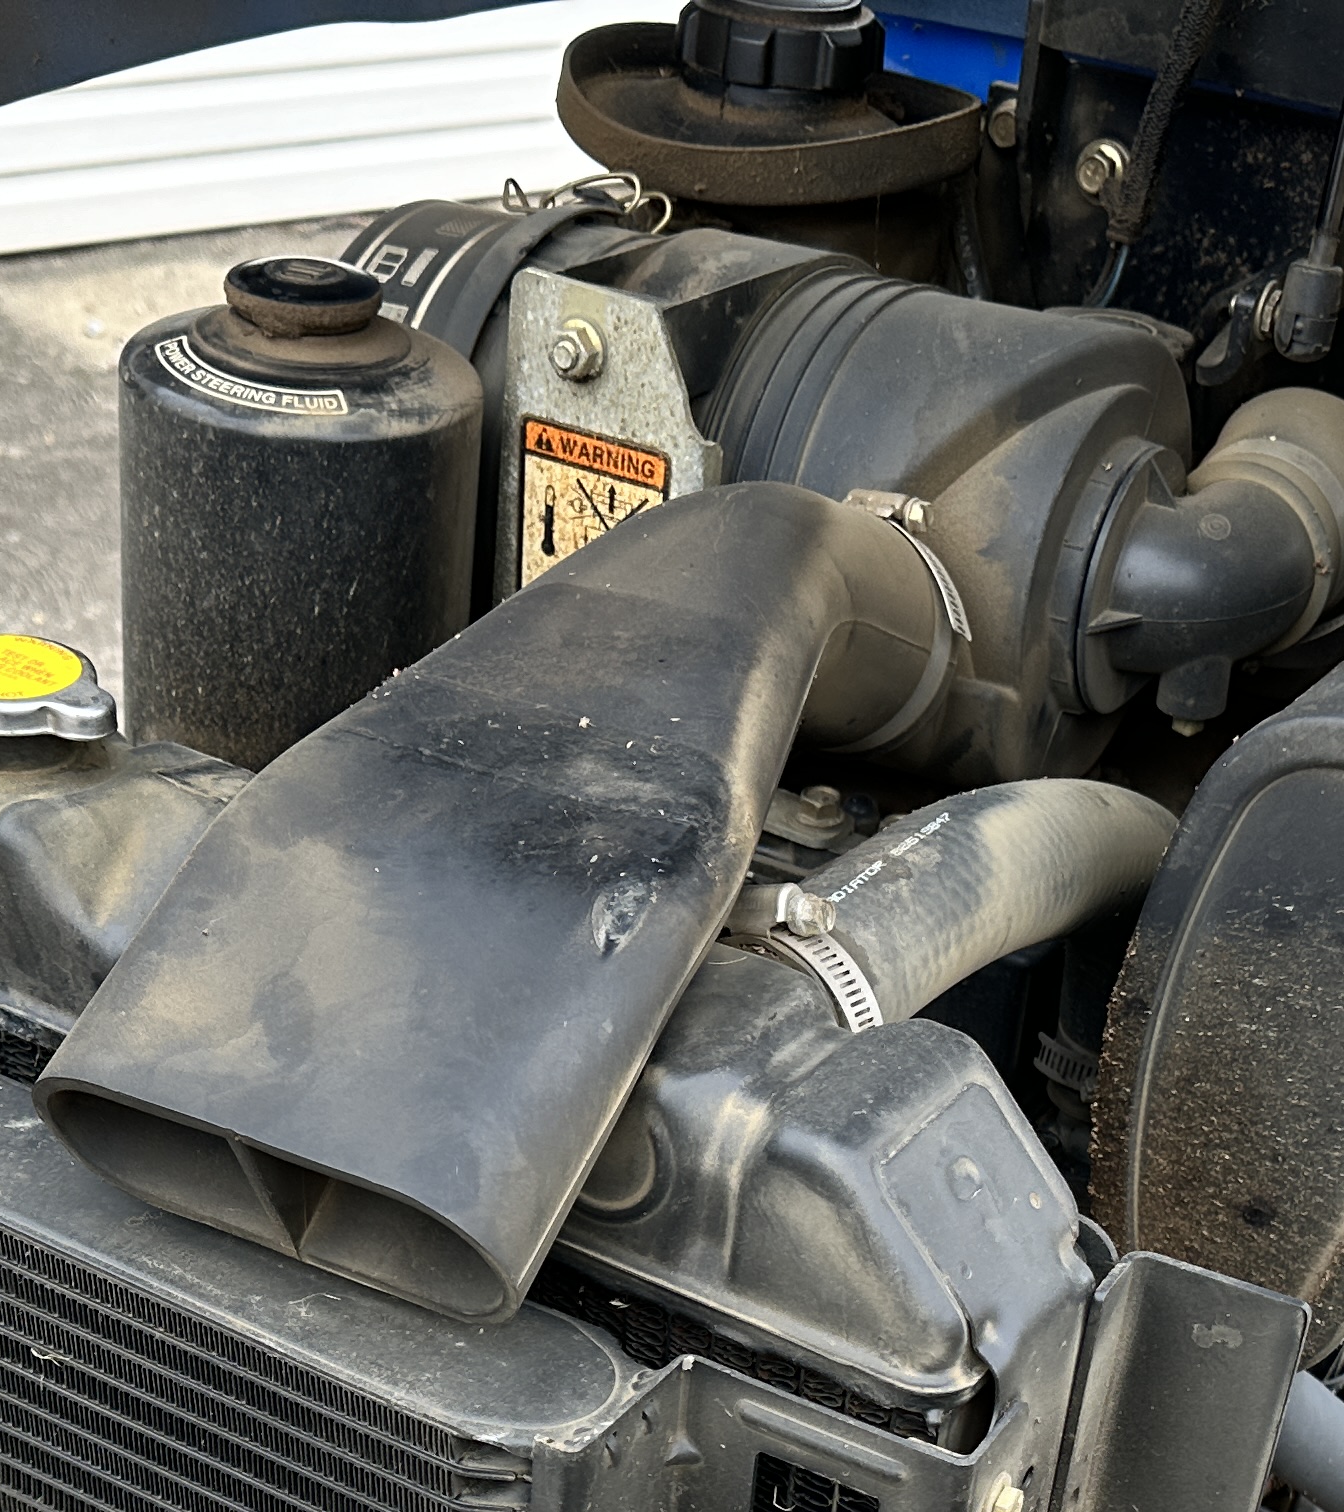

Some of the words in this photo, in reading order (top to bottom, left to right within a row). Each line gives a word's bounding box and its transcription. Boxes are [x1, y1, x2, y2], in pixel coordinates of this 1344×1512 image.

[165, 342, 197, 374] POWER
[191, 370, 276, 404] STEERING
[281, 395, 338, 410] FLUID
[559, 434, 655, 480] WARNING
[826, 856, 889, 906] ADIATOR
